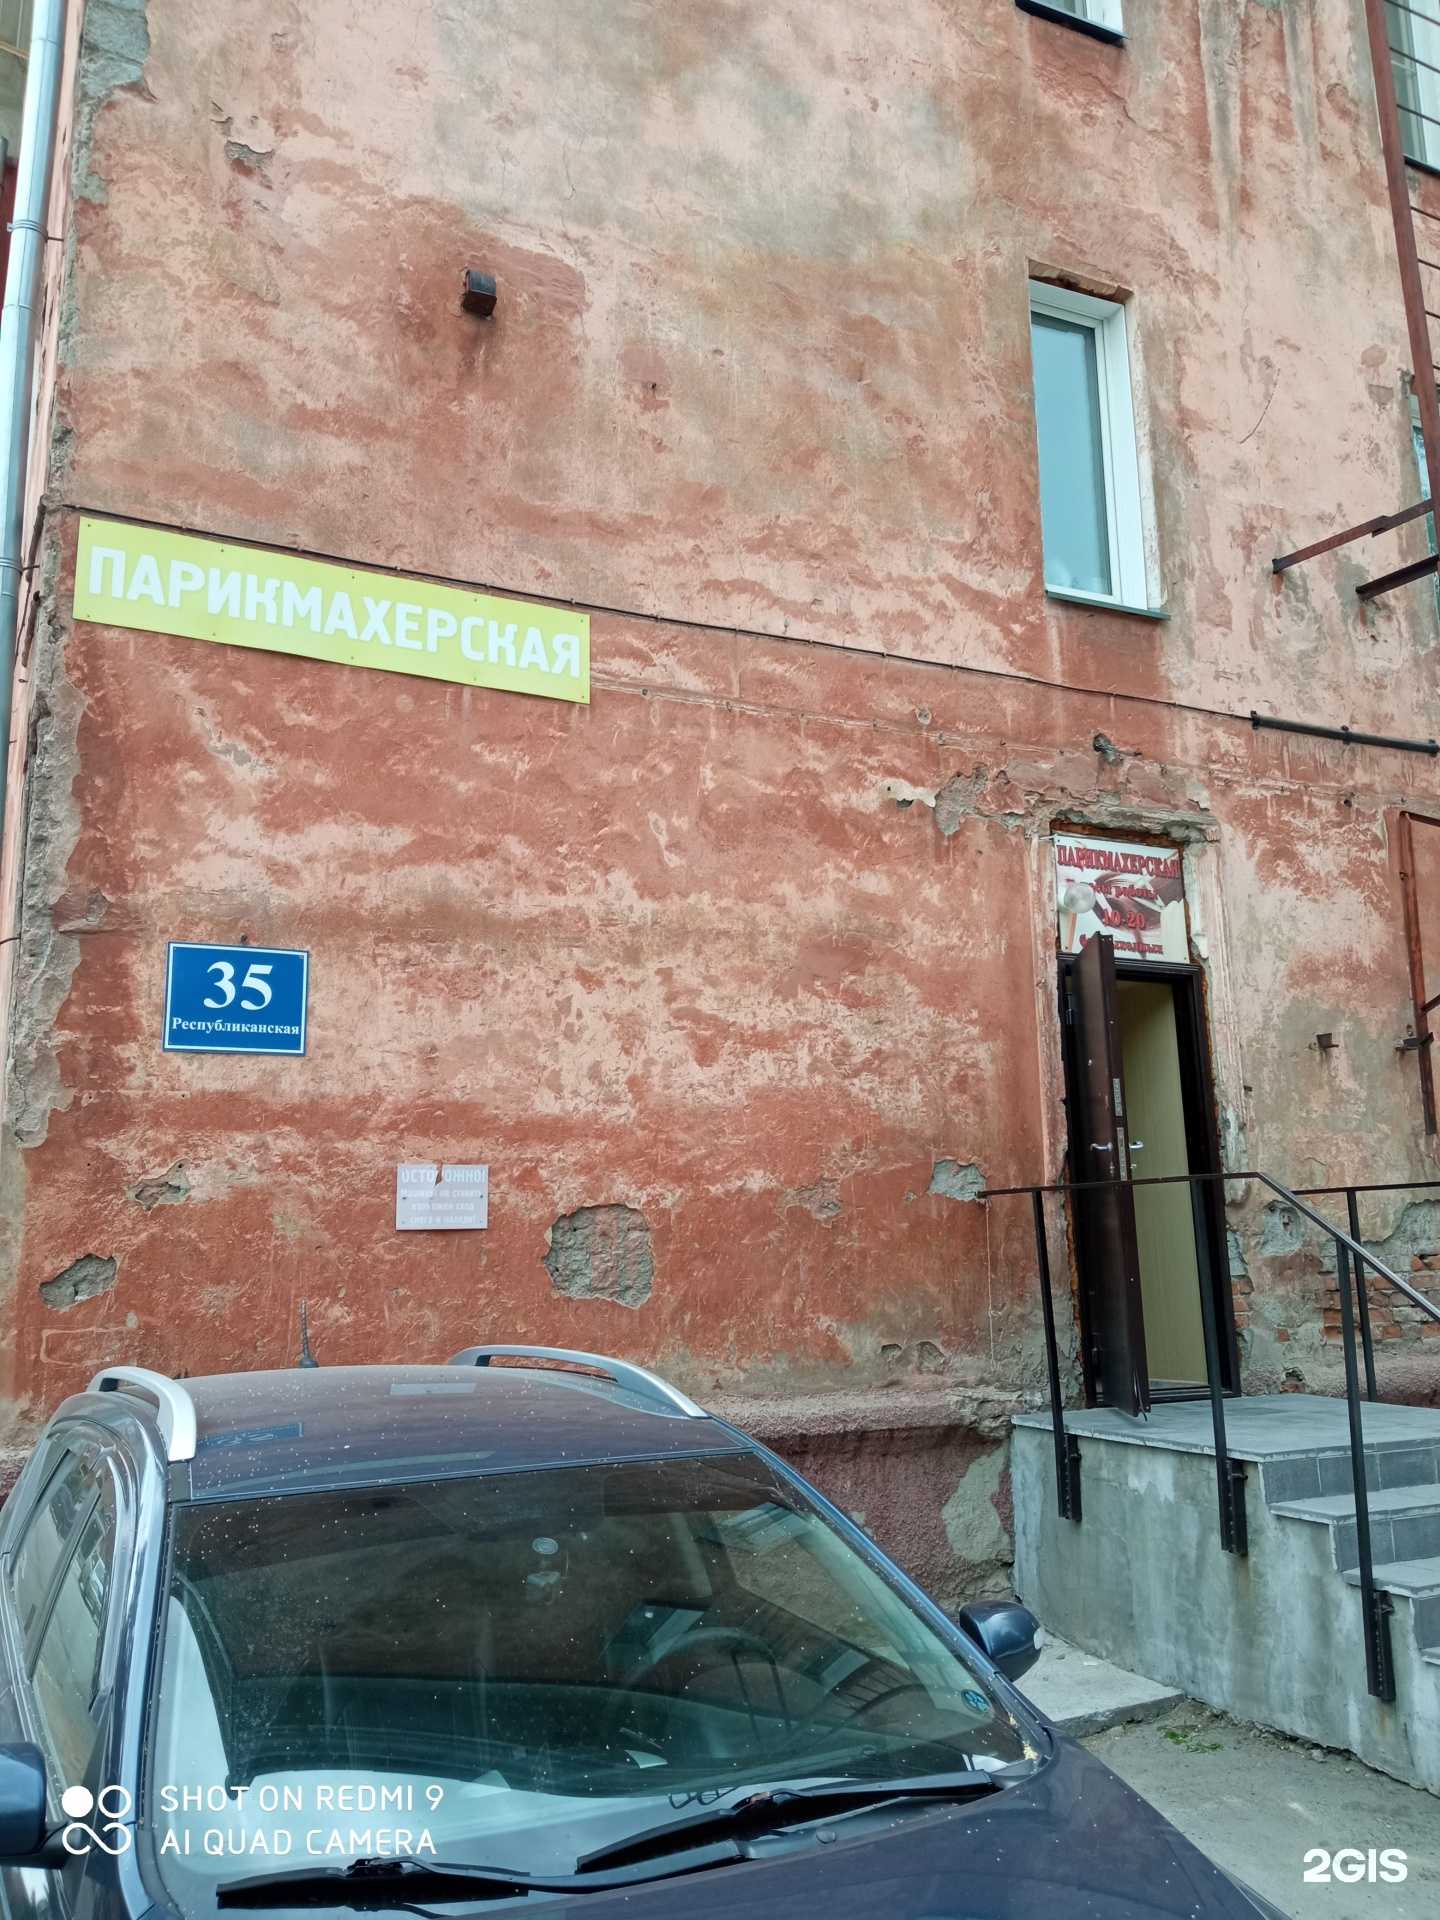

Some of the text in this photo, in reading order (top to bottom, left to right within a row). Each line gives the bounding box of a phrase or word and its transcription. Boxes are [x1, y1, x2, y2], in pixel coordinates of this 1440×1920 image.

[89, 546, 582, 678] ПАРИКМАХЕРСКАЯ
[1055, 844, 1180, 878] ПАРИКМАХЕРСКАЯ
[203, 961, 273, 1011] 35
[172, 1017, 299, 1035] Республиканская
[400, 1168, 486, 1184] ОСТООЖНО!
